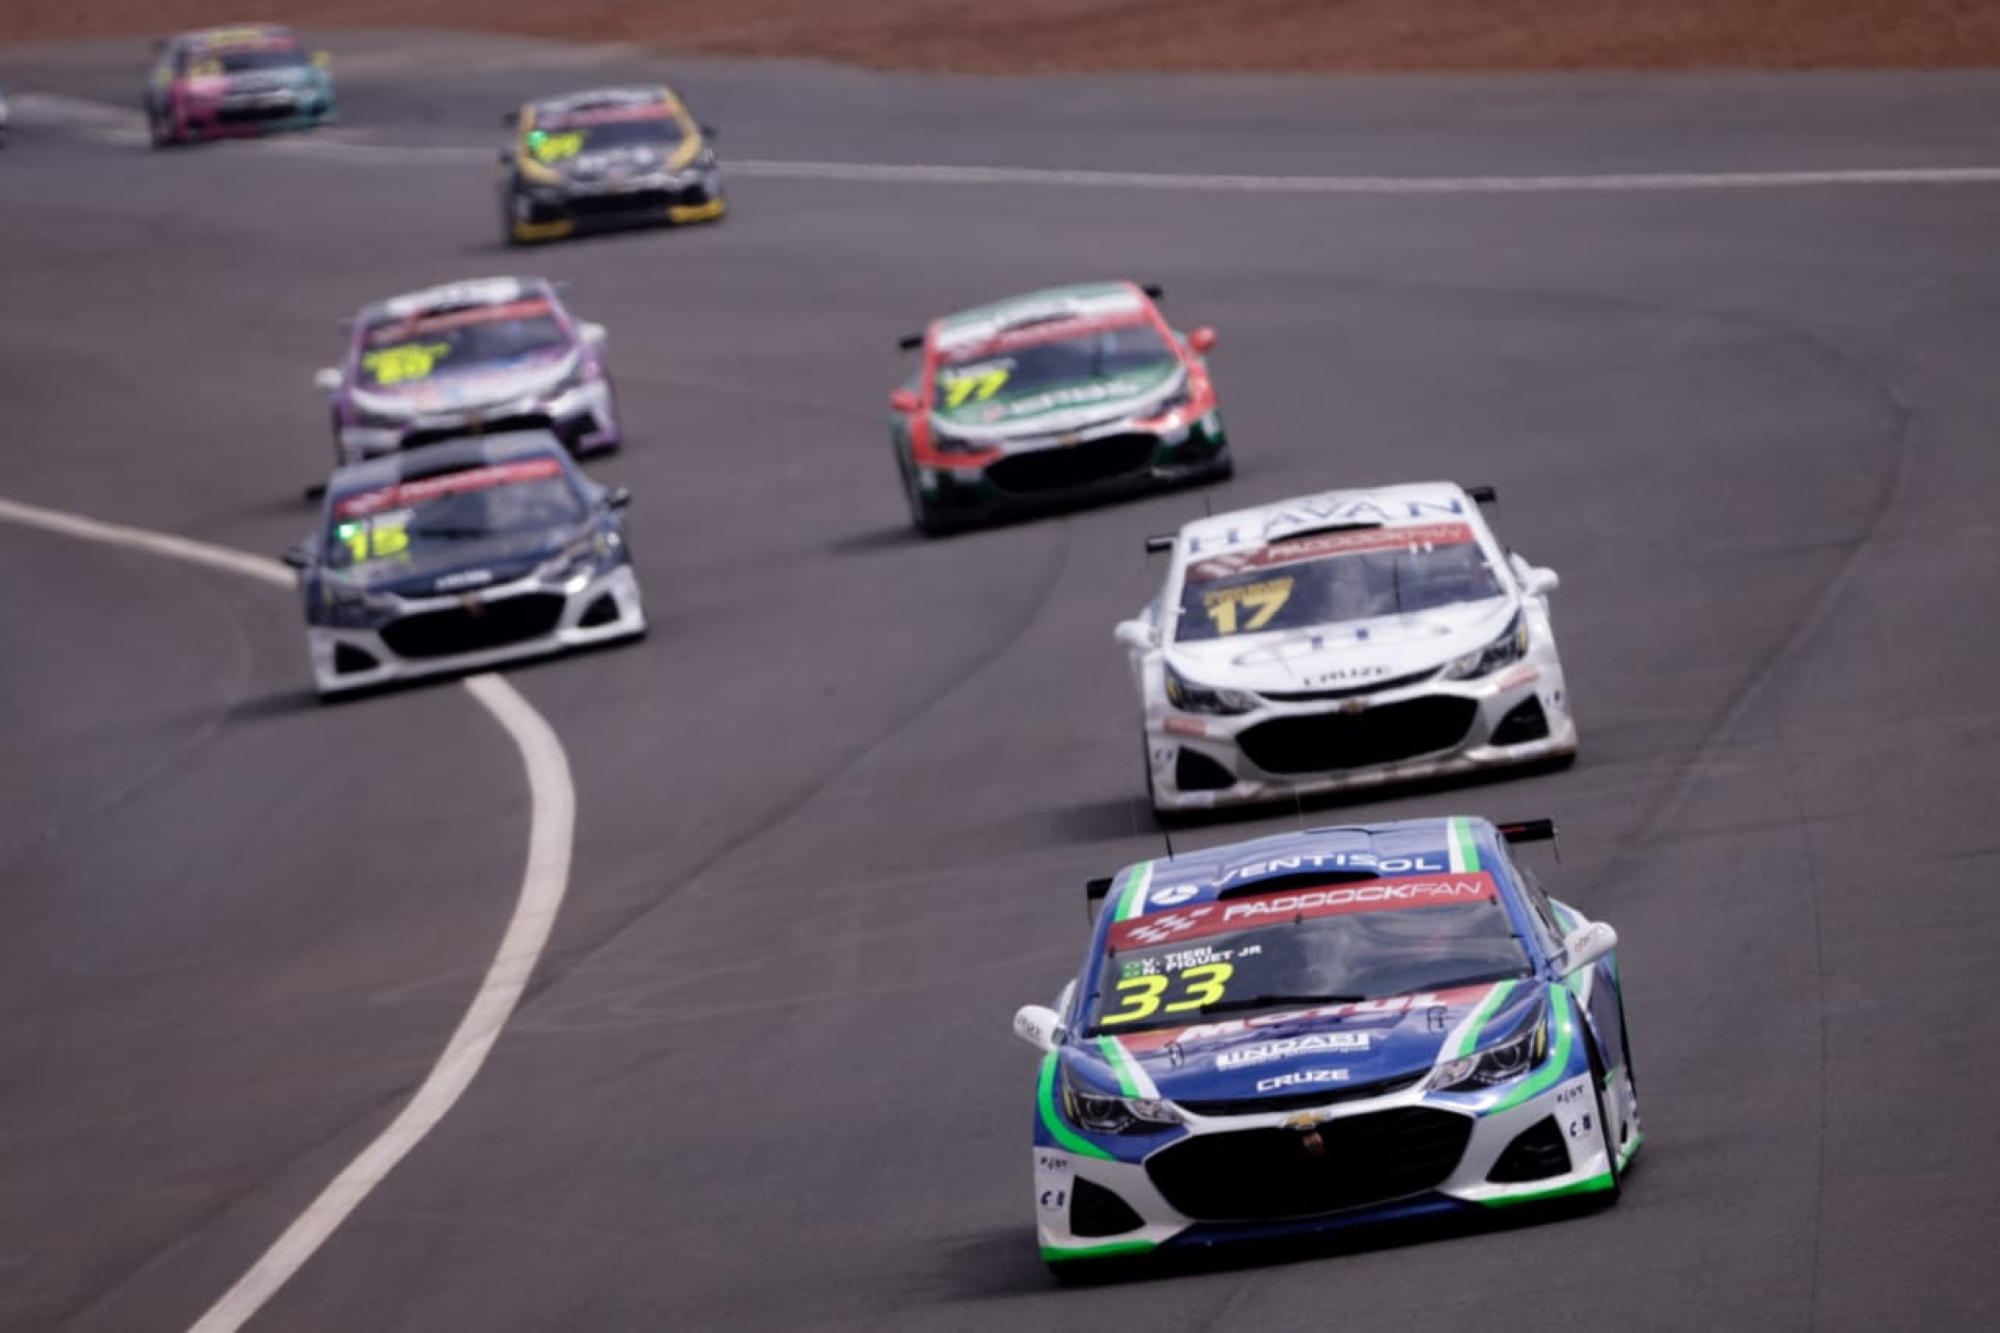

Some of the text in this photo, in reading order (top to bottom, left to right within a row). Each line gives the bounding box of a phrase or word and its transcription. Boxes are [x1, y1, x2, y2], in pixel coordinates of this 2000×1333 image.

[1208, 586, 1294, 636] 17
[1211, 853, 1443, 888] VENTISOL
[1223, 881, 1482, 923] PADDOCKFAN
[1164, 946, 1213, 963] TIERI
[1166, 950, 1234, 972] PIQUET
[1238, 944, 1262, 958] JR
[1100, 962, 1234, 1026] 33
[1256, 1069, 1350, 1092] CRUZE
